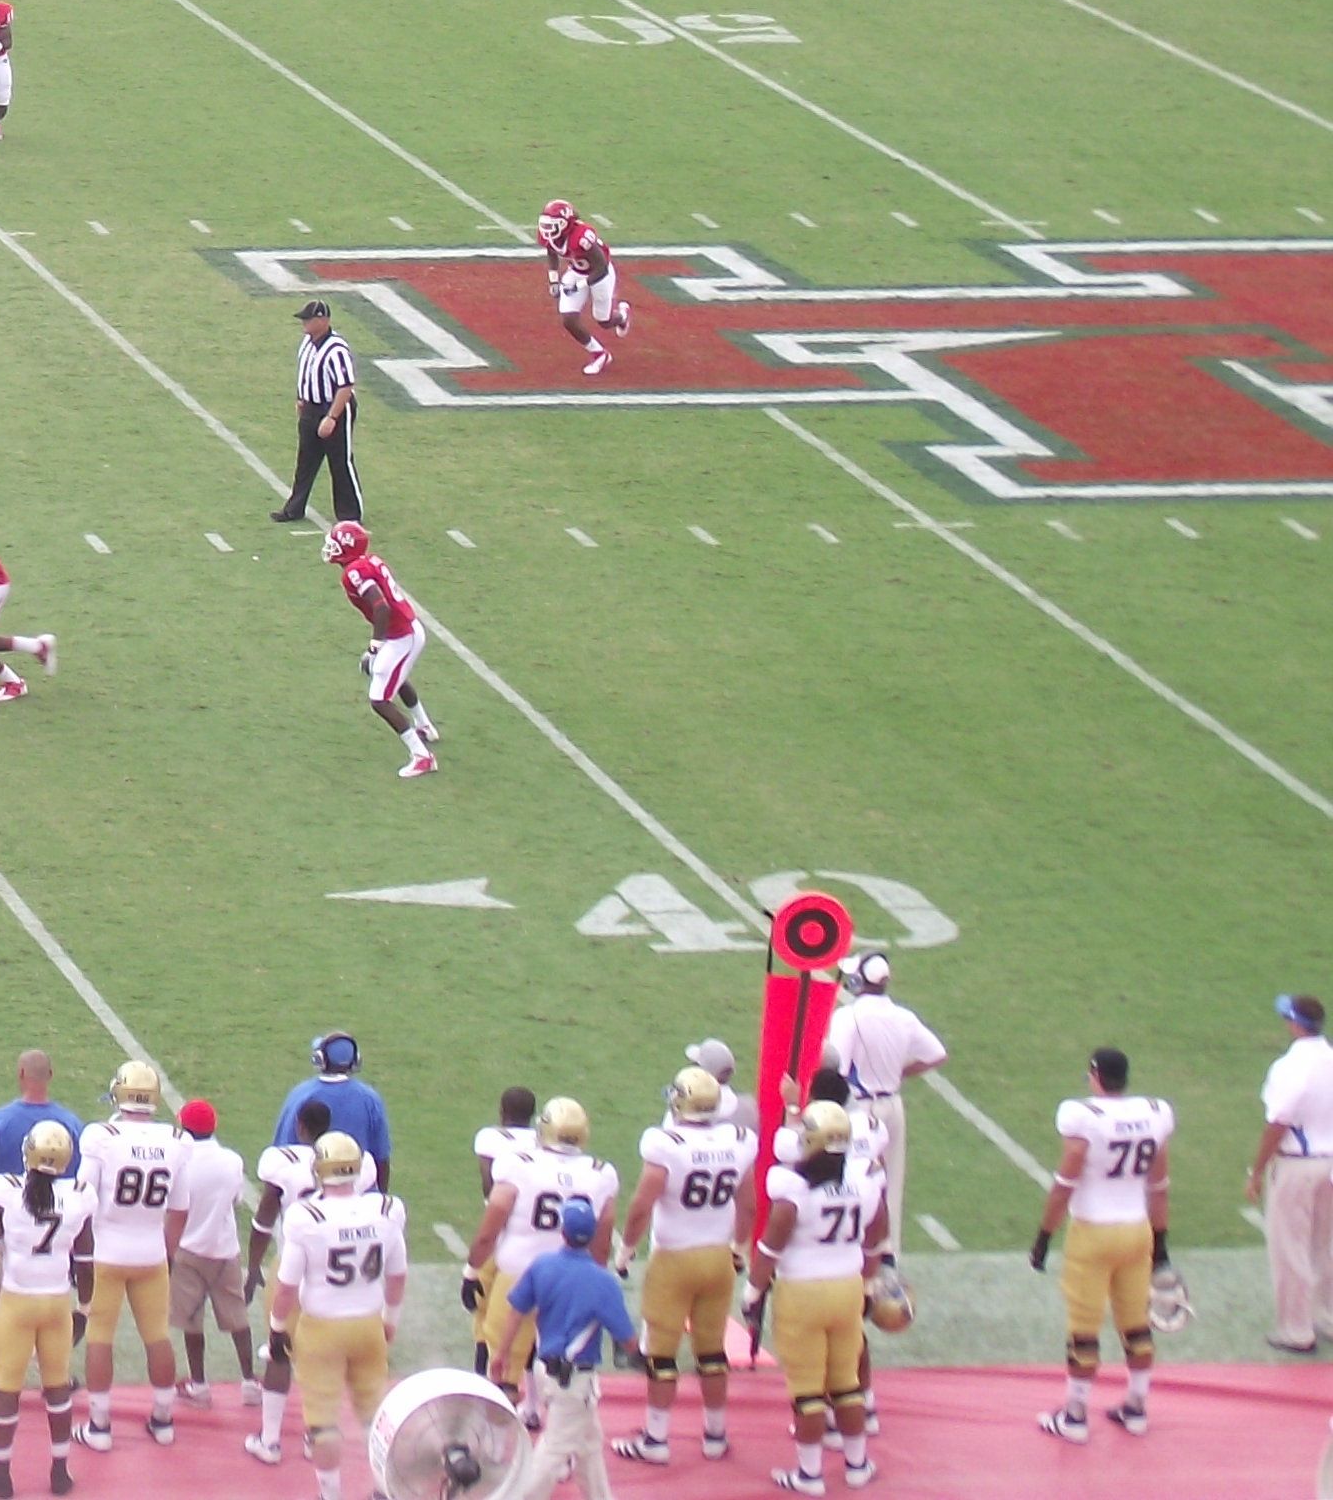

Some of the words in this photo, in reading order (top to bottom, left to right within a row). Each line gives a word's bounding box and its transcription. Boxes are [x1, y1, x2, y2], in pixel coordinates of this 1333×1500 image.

[545, 13, 802, 45] 50
[574, 869, 959, 952] 40
[131, 1145, 166, 1161] NELSON
[1106, 1139, 1156, 1178] 78
[114, 1166, 172, 1208] 86
[680, 1170, 738, 1209] 66
[32, 1214, 64, 1255] 7
[819, 1205, 861, 1243] 71
[326, 1243, 385, 1288] 54
